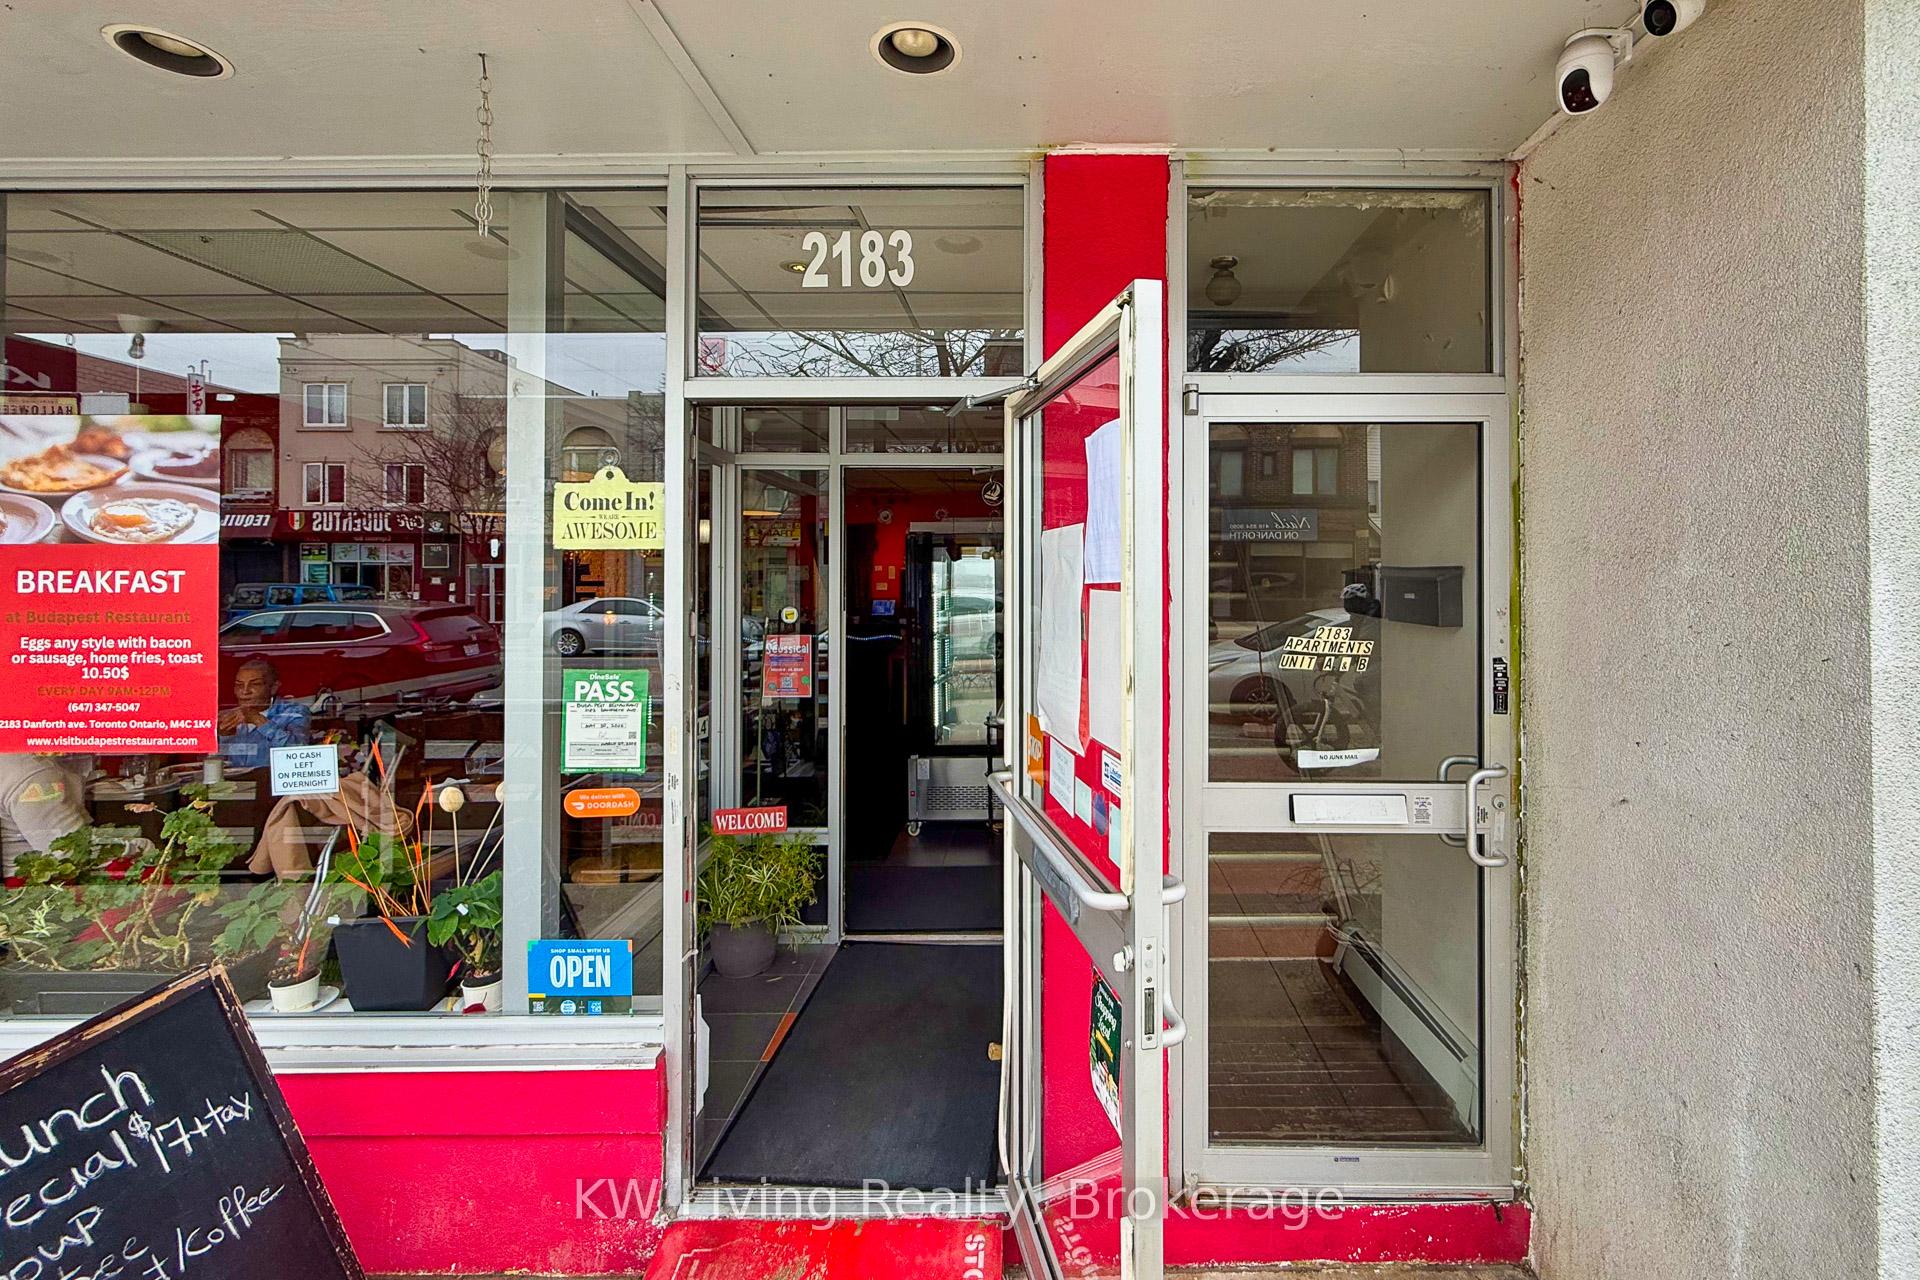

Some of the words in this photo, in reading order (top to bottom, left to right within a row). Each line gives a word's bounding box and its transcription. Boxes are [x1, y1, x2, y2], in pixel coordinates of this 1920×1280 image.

[801, 229, 915, 288] 2183
[564, 491, 622, 511] Come
[625, 491, 655, 511] In!
[561, 522, 657, 540] AWESOME
[17, 570, 186, 593] BREAKFAST
[6, 612, 20, 623] at
[27, 611, 100, 625] Budapest
[105, 611, 190, 623] Restaurant
[1316, 628, 1351, 640] 2183
[20, 637, 50, 651] Eggs
[54, 639, 78, 651] any
[81, 636, 115, 651] style
[117, 636, 147, 648] with
[150, 636, 191, 648] bacon
[1285, 638, 1373, 654] APARTMENTS
[11, 654, 26, 664] or
[29, 654, 87, 666] sausage,
[90, 652, 128, 664] home
[131, 652, 165, 666] fries,
[168, 653, 203, 664] toast
[1281, 655, 1315, 669] UNIT
[1324, 656, 1333, 669] A
[1358, 658, 1367, 670] B
[82, 667, 129, 680] 10.50$
[38, 687, 75, 696] EVERY
[80, 687, 104, 696] DAY
[575, 681, 635, 702] PASS
[68, 703, 93, 713] (647)
[95, 703, 141, 712] 347-5047
[0, 720, 21, 728] 2183
[23, 719, 65, 729] Danforth
[67, 721, 87, 729] ave.
[89, 719, 127, 729] Toronto
[129, 719, 168, 730] Ontario,
[170, 720, 192, 729] M4C
[193, 719, 212, 729] 1K4
[27, 737, 198, 747] www.visitbudapestrestaurant.com
[294, 761, 314, 769] LEFT
[291, 770, 332, 778] PREMISES
[282, 779, 328, 788] OVERNIGHT
[716, 812, 784, 831] WELCOME
[550, 955, 611, 988] OPEN
[0, 1064, 155, 1175] unch
[1, 1130, 138, 1228] ecial
[0, 1205, 104, 1280] oup
